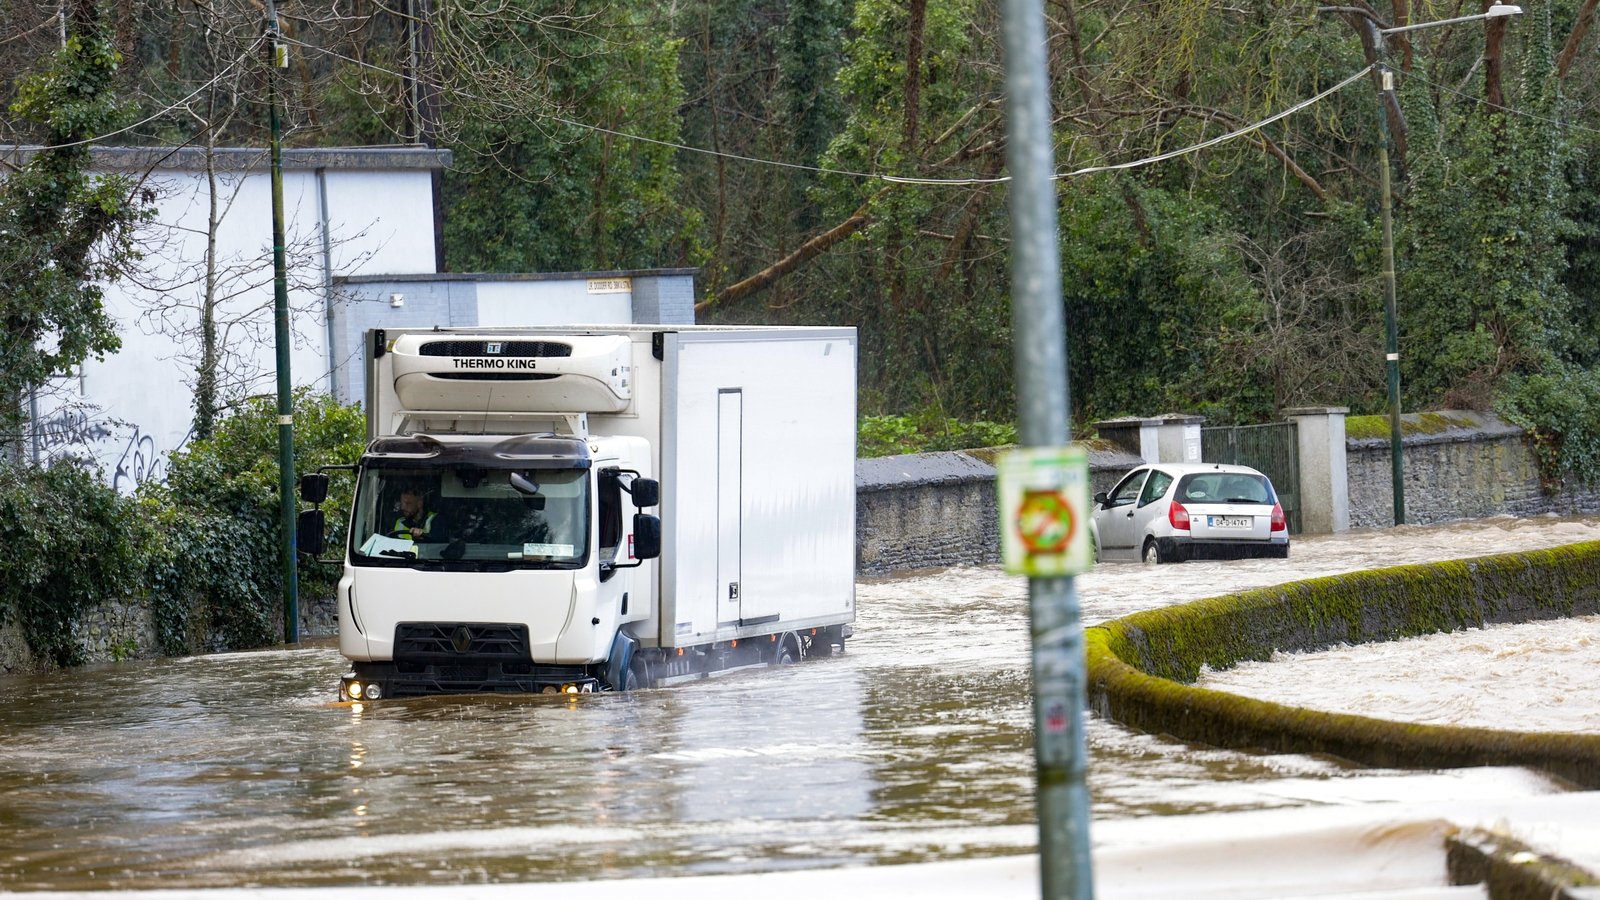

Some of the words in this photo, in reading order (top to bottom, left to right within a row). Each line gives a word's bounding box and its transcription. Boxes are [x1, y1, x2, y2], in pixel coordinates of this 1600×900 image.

[453, 359, 504, 368] THERMO
[507, 359, 536, 369] KING
[1216, 518, 1247, 526] 04-D-14747
